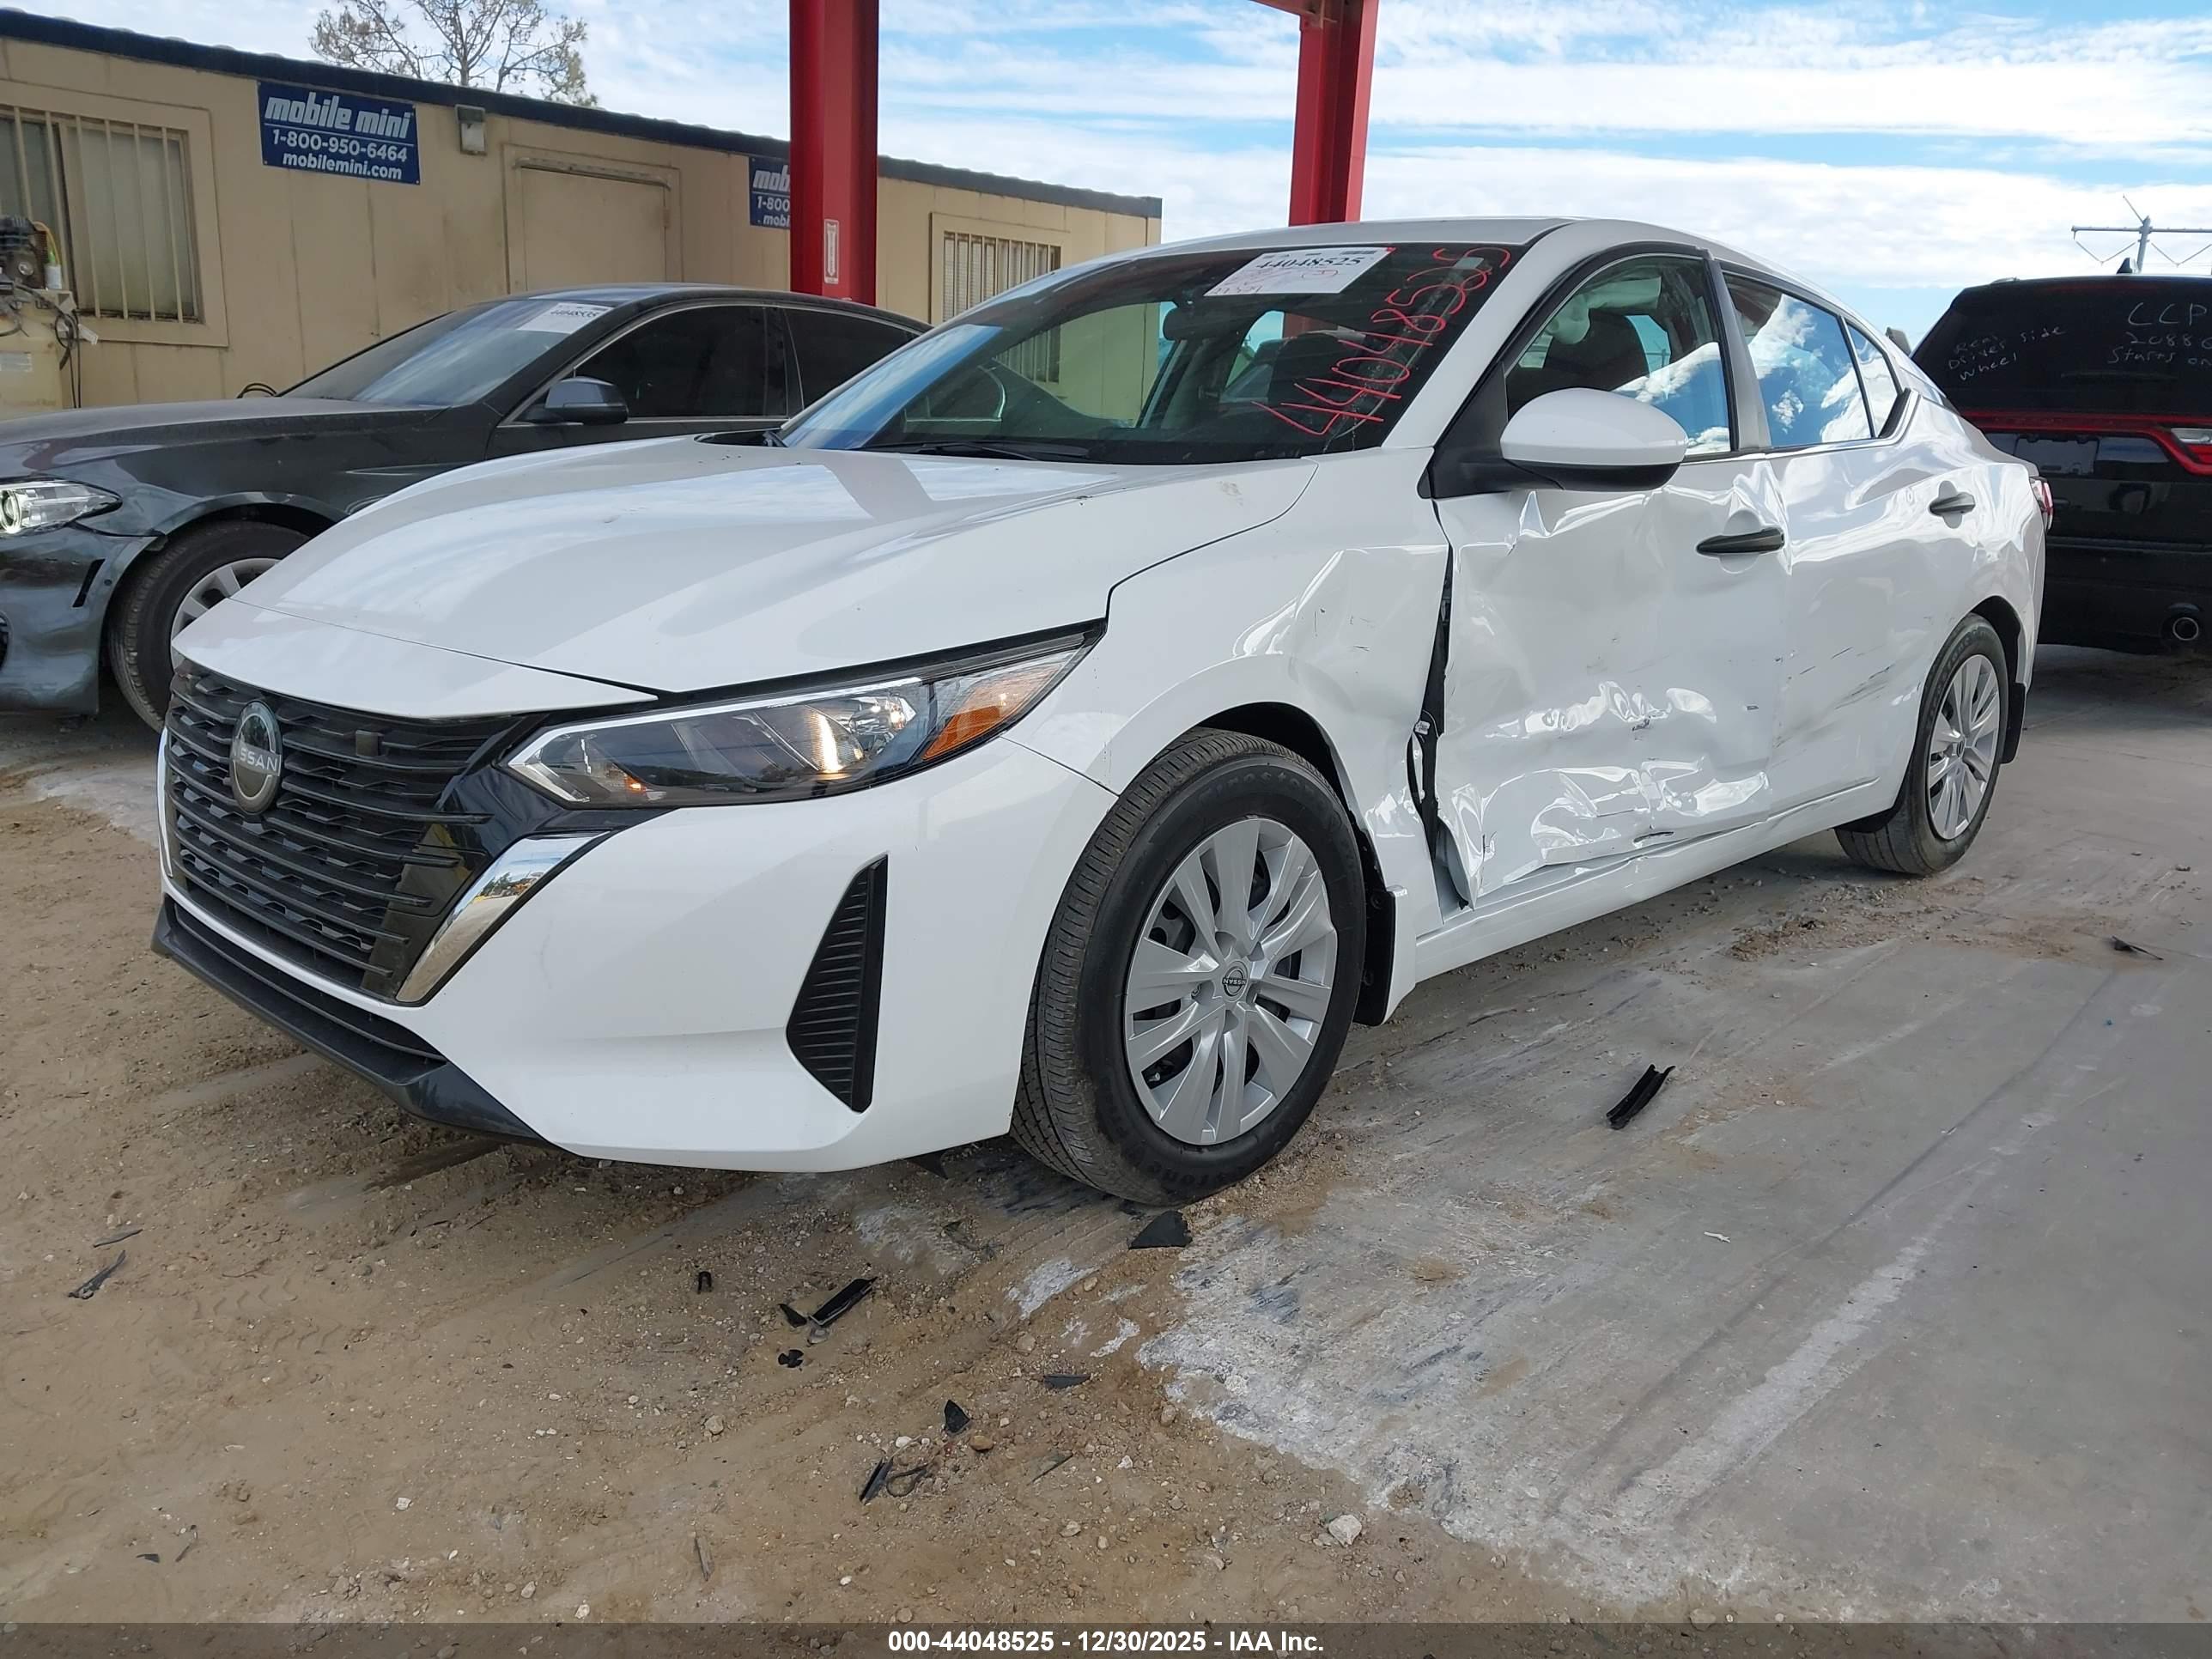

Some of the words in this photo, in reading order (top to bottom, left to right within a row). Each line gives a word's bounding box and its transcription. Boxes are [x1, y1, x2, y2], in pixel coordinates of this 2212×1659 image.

[264, 92, 352, 130] mobile
[355, 107, 412, 139] mini
[272, 129, 408, 162] 1-800-950-6464
[283, 152, 403, 180] mobilemini.com
[1255, 257, 1364, 269] 44048525
[2128, 301, 2208, 326] CCP
[1250, 246, 1512, 436] 44048525
[234, 744, 278, 773] SSAN
